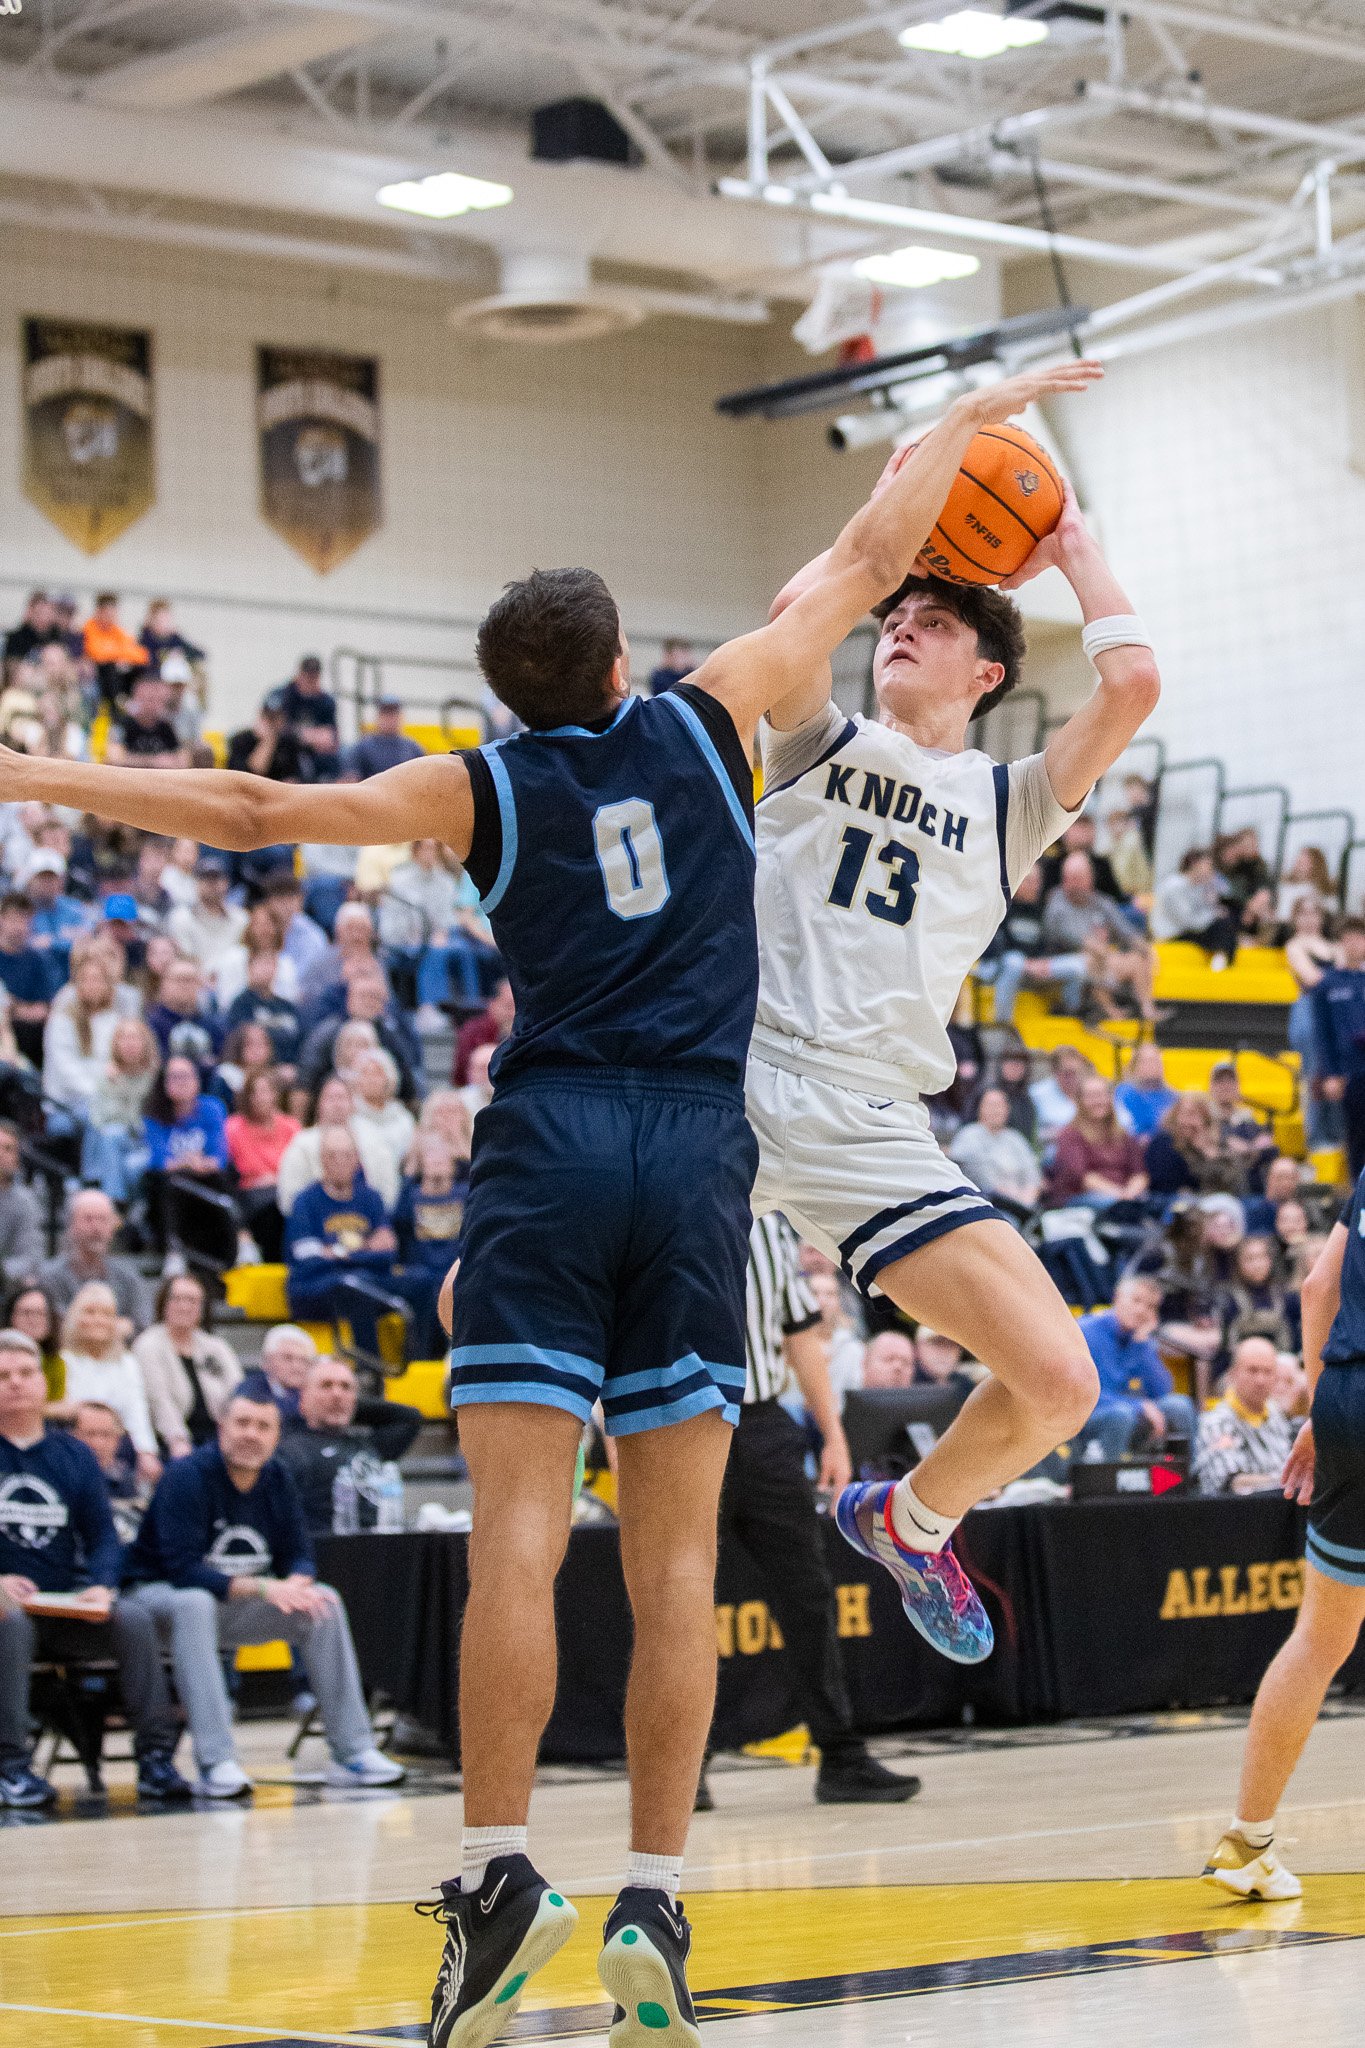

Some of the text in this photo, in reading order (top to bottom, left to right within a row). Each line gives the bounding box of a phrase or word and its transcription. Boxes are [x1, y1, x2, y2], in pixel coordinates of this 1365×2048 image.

[919, 537, 986, 587] ilso
[970, 520, 1002, 549] NFHS
[824, 762, 970, 853] KNOCH
[591, 796, 671, 922] 0
[825, 822, 922, 928] 13
[1159, 1558, 1306, 1620] ALLEG
